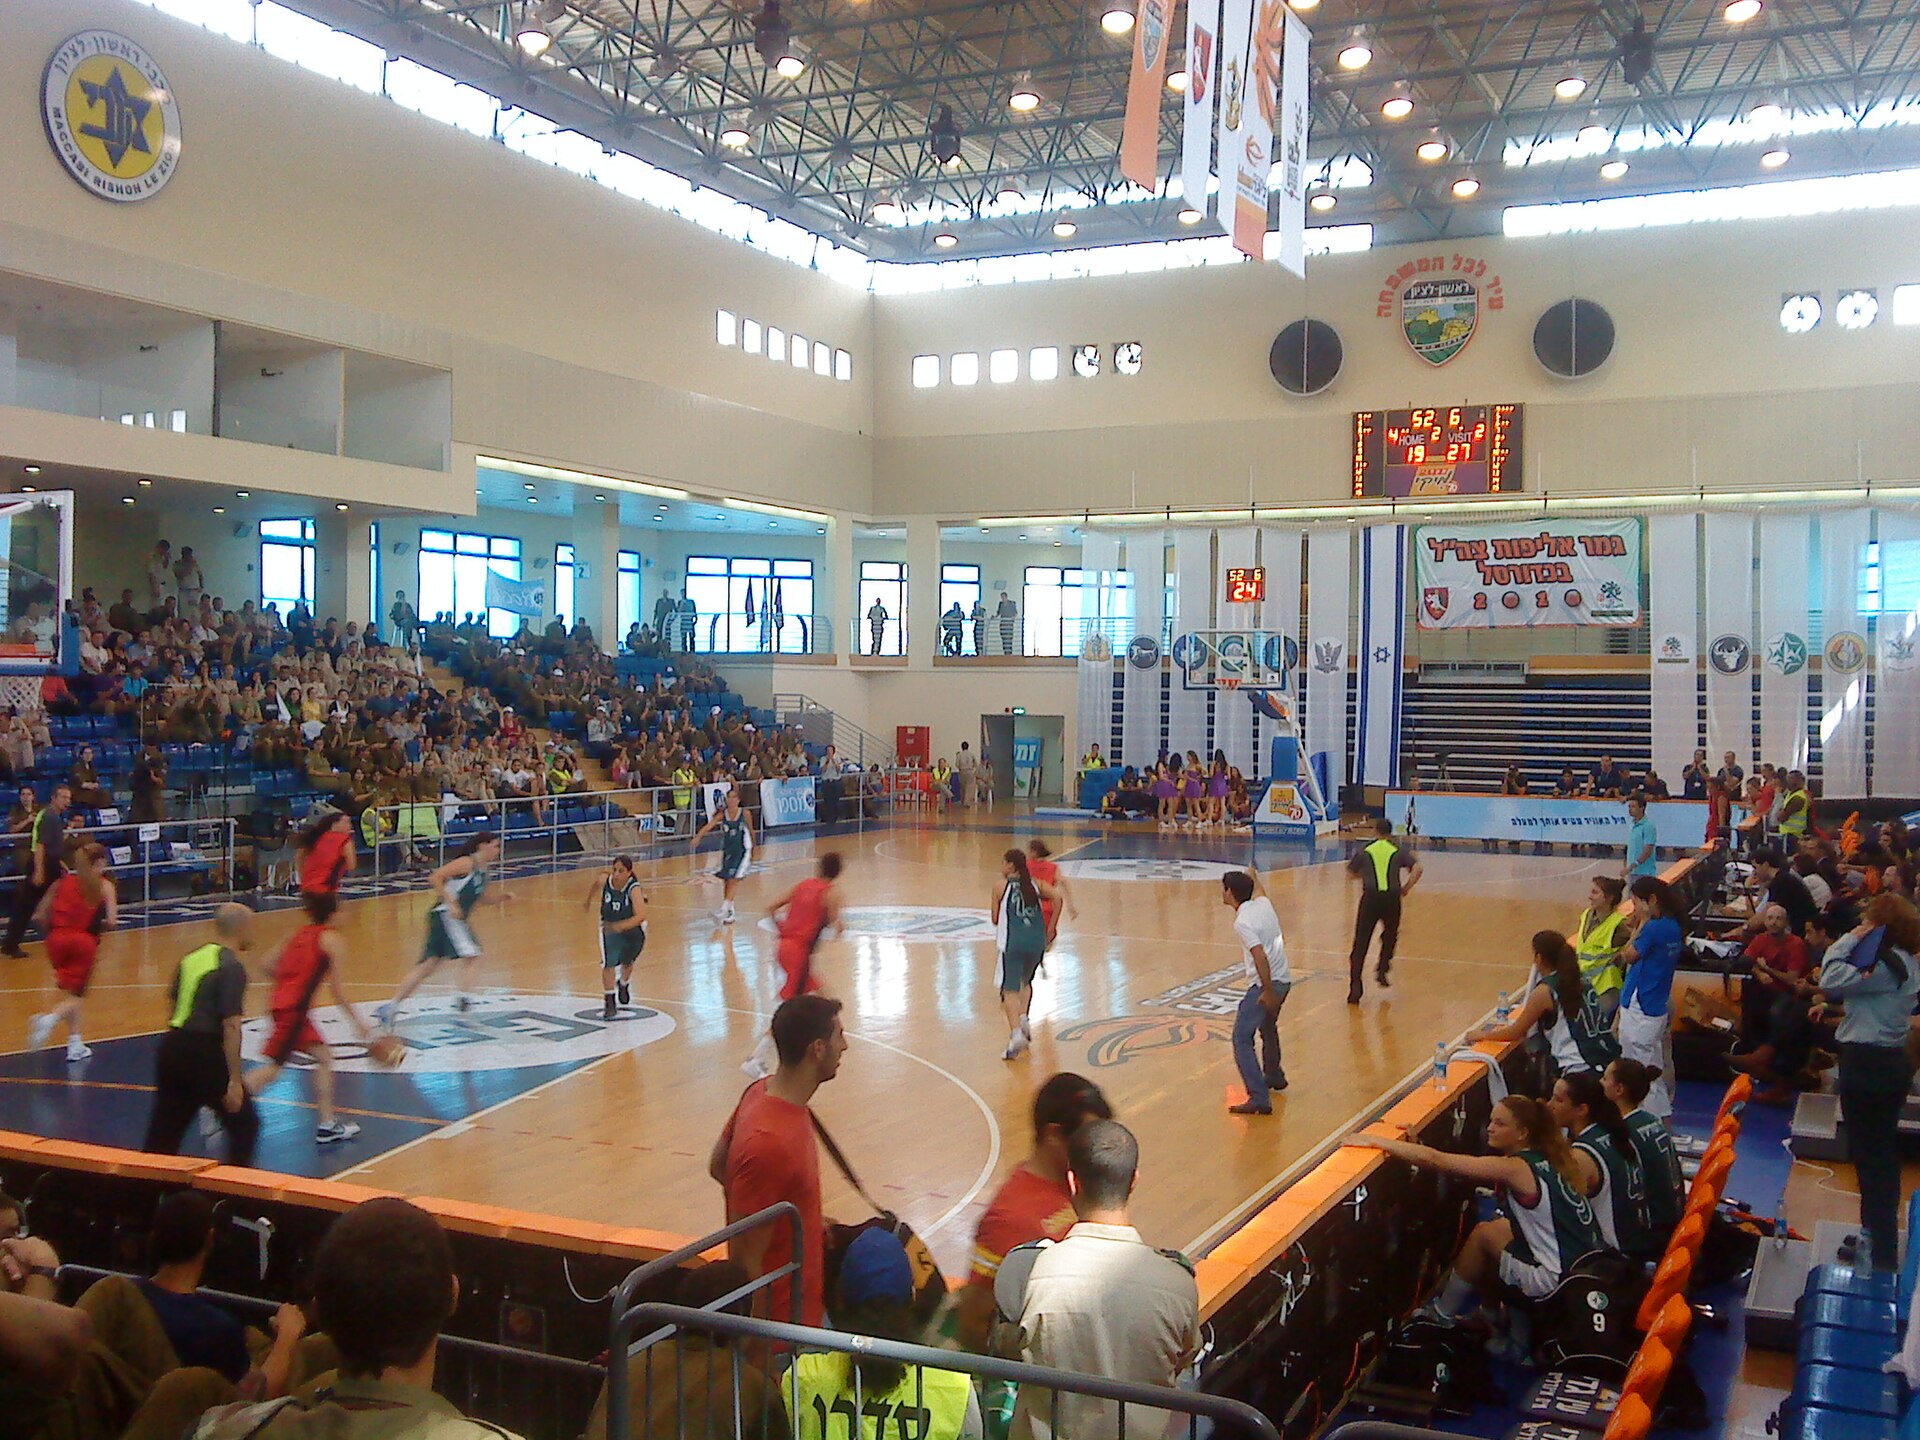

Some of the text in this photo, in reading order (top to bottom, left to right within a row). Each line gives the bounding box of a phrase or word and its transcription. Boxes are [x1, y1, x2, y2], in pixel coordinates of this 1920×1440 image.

[54, 36, 87, 75] לציון
[94, 36, 140, 62] ראשון
[52, 106, 89, 178] MACCABI
[93, 174, 142, 195] RISHON
[145, 174, 159, 189] LE
[1452, 253, 1487, 278] לכל
[1376, 256, 1445, 318] המשפחה
[1410, 282, 1470, 299] ראשון-לציון
[1412, 407, 1460, 428] 52 6
[1388, 424, 1485, 443] 4 2 2
[1398, 431, 1473, 446] HOME VISIT
[1407, 443, 1471, 463] 19 27
[1491, 531, 1577, 559] אליפות
[1578, 534, 1626, 557] גמר
[1228, 569, 1262, 582] 52 6
[1475, 560, 1574, 585] בכדורסל
[1232, 582, 1258, 600] 24
[1289, 807, 1301, 820] 70
[611, 901, 621, 911] 10
[1593, 1312, 1607, 1333] 9
